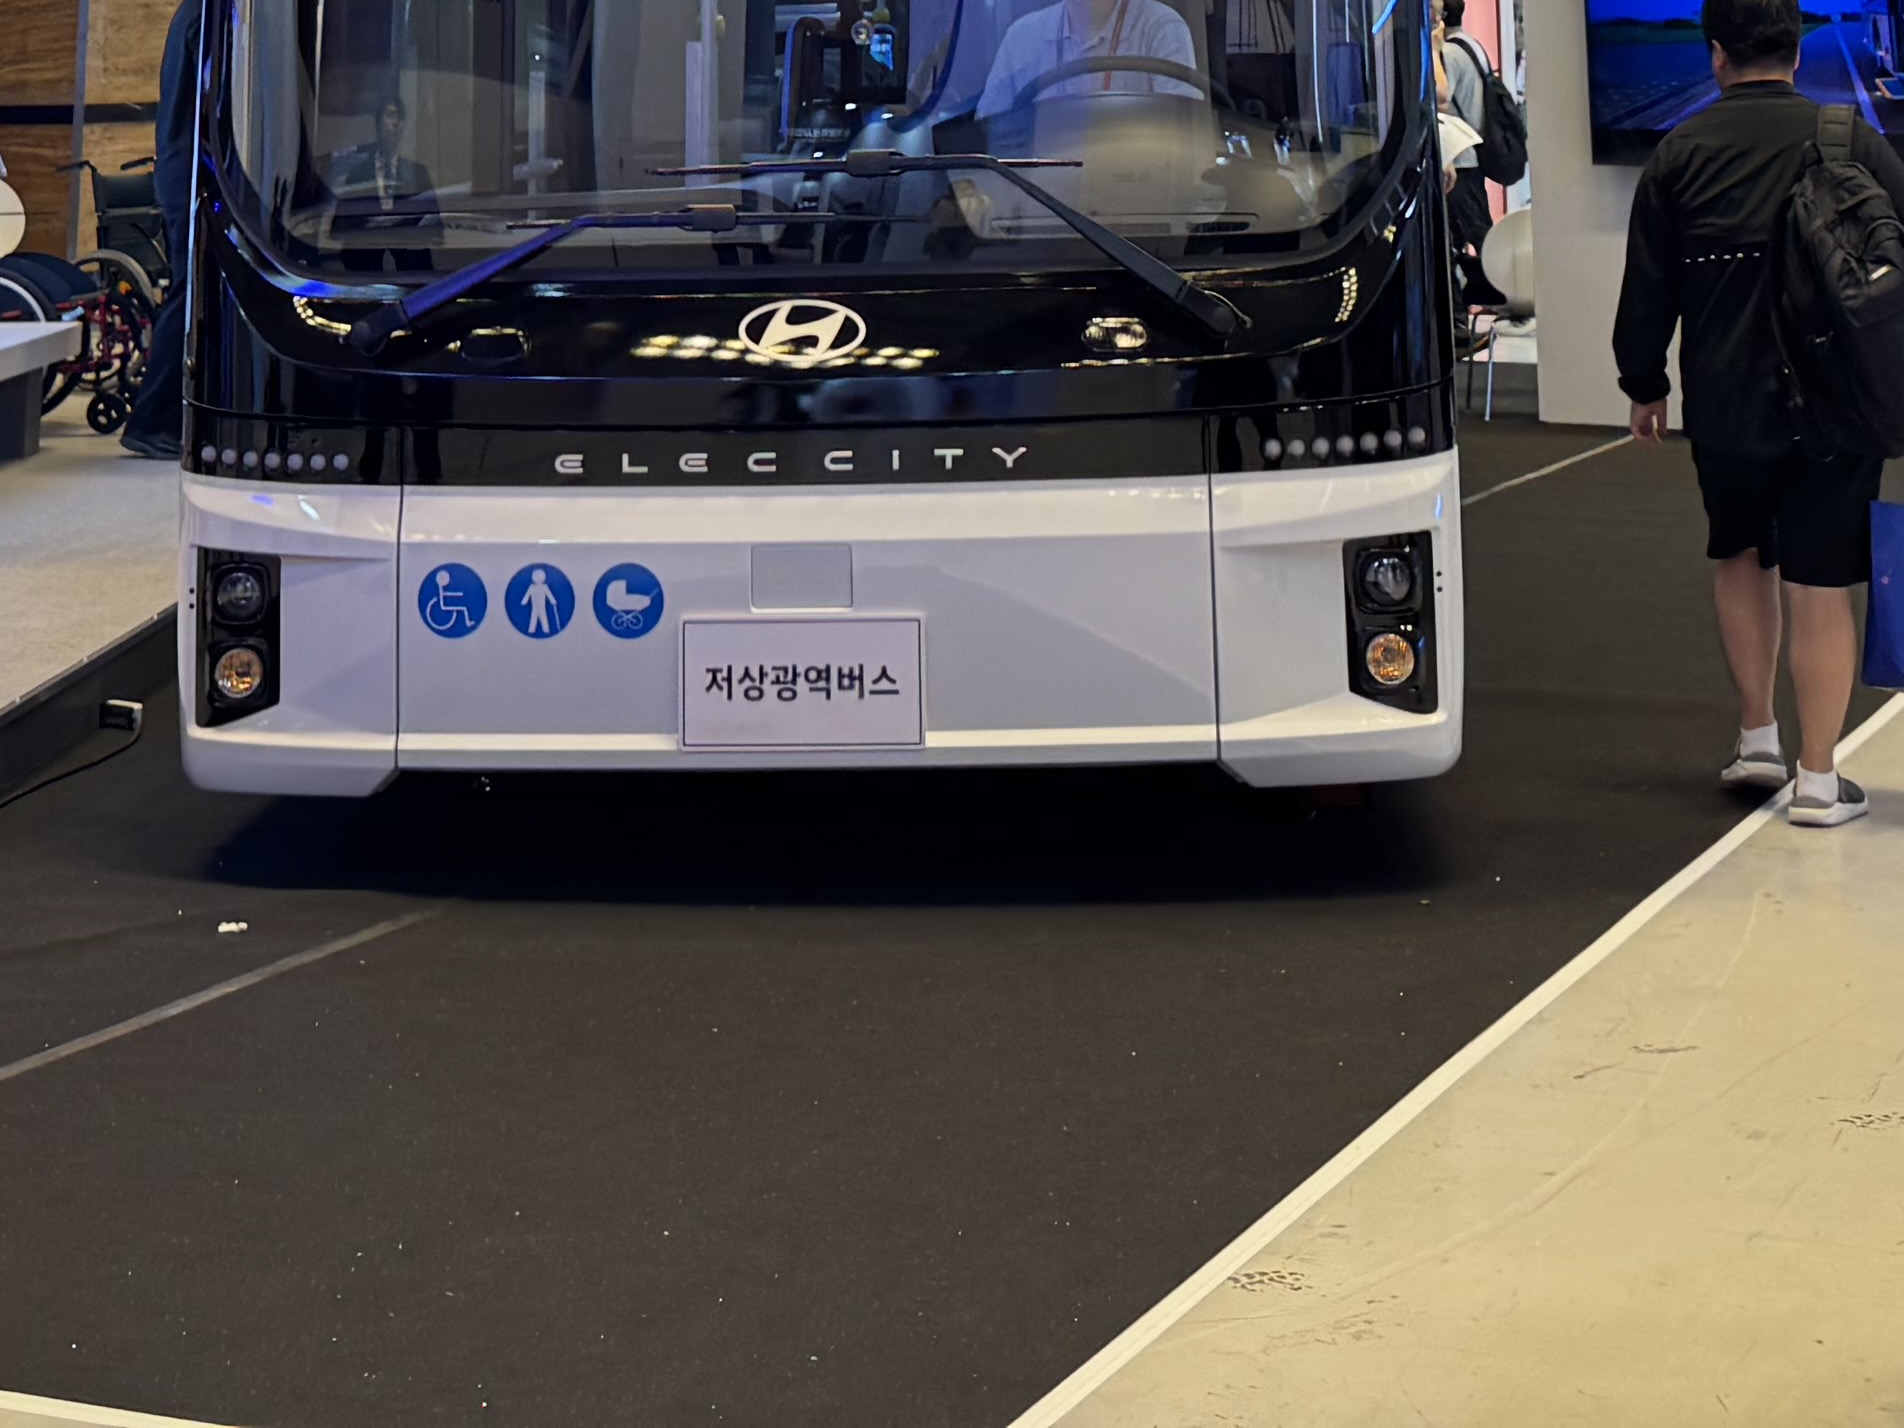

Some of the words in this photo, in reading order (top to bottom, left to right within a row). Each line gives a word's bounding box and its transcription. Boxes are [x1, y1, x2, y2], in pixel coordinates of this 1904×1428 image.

[554, 451, 777, 475] ELEC
[824, 446, 1028, 472] CITY
[703, 661, 902, 703] 저상광역버스
